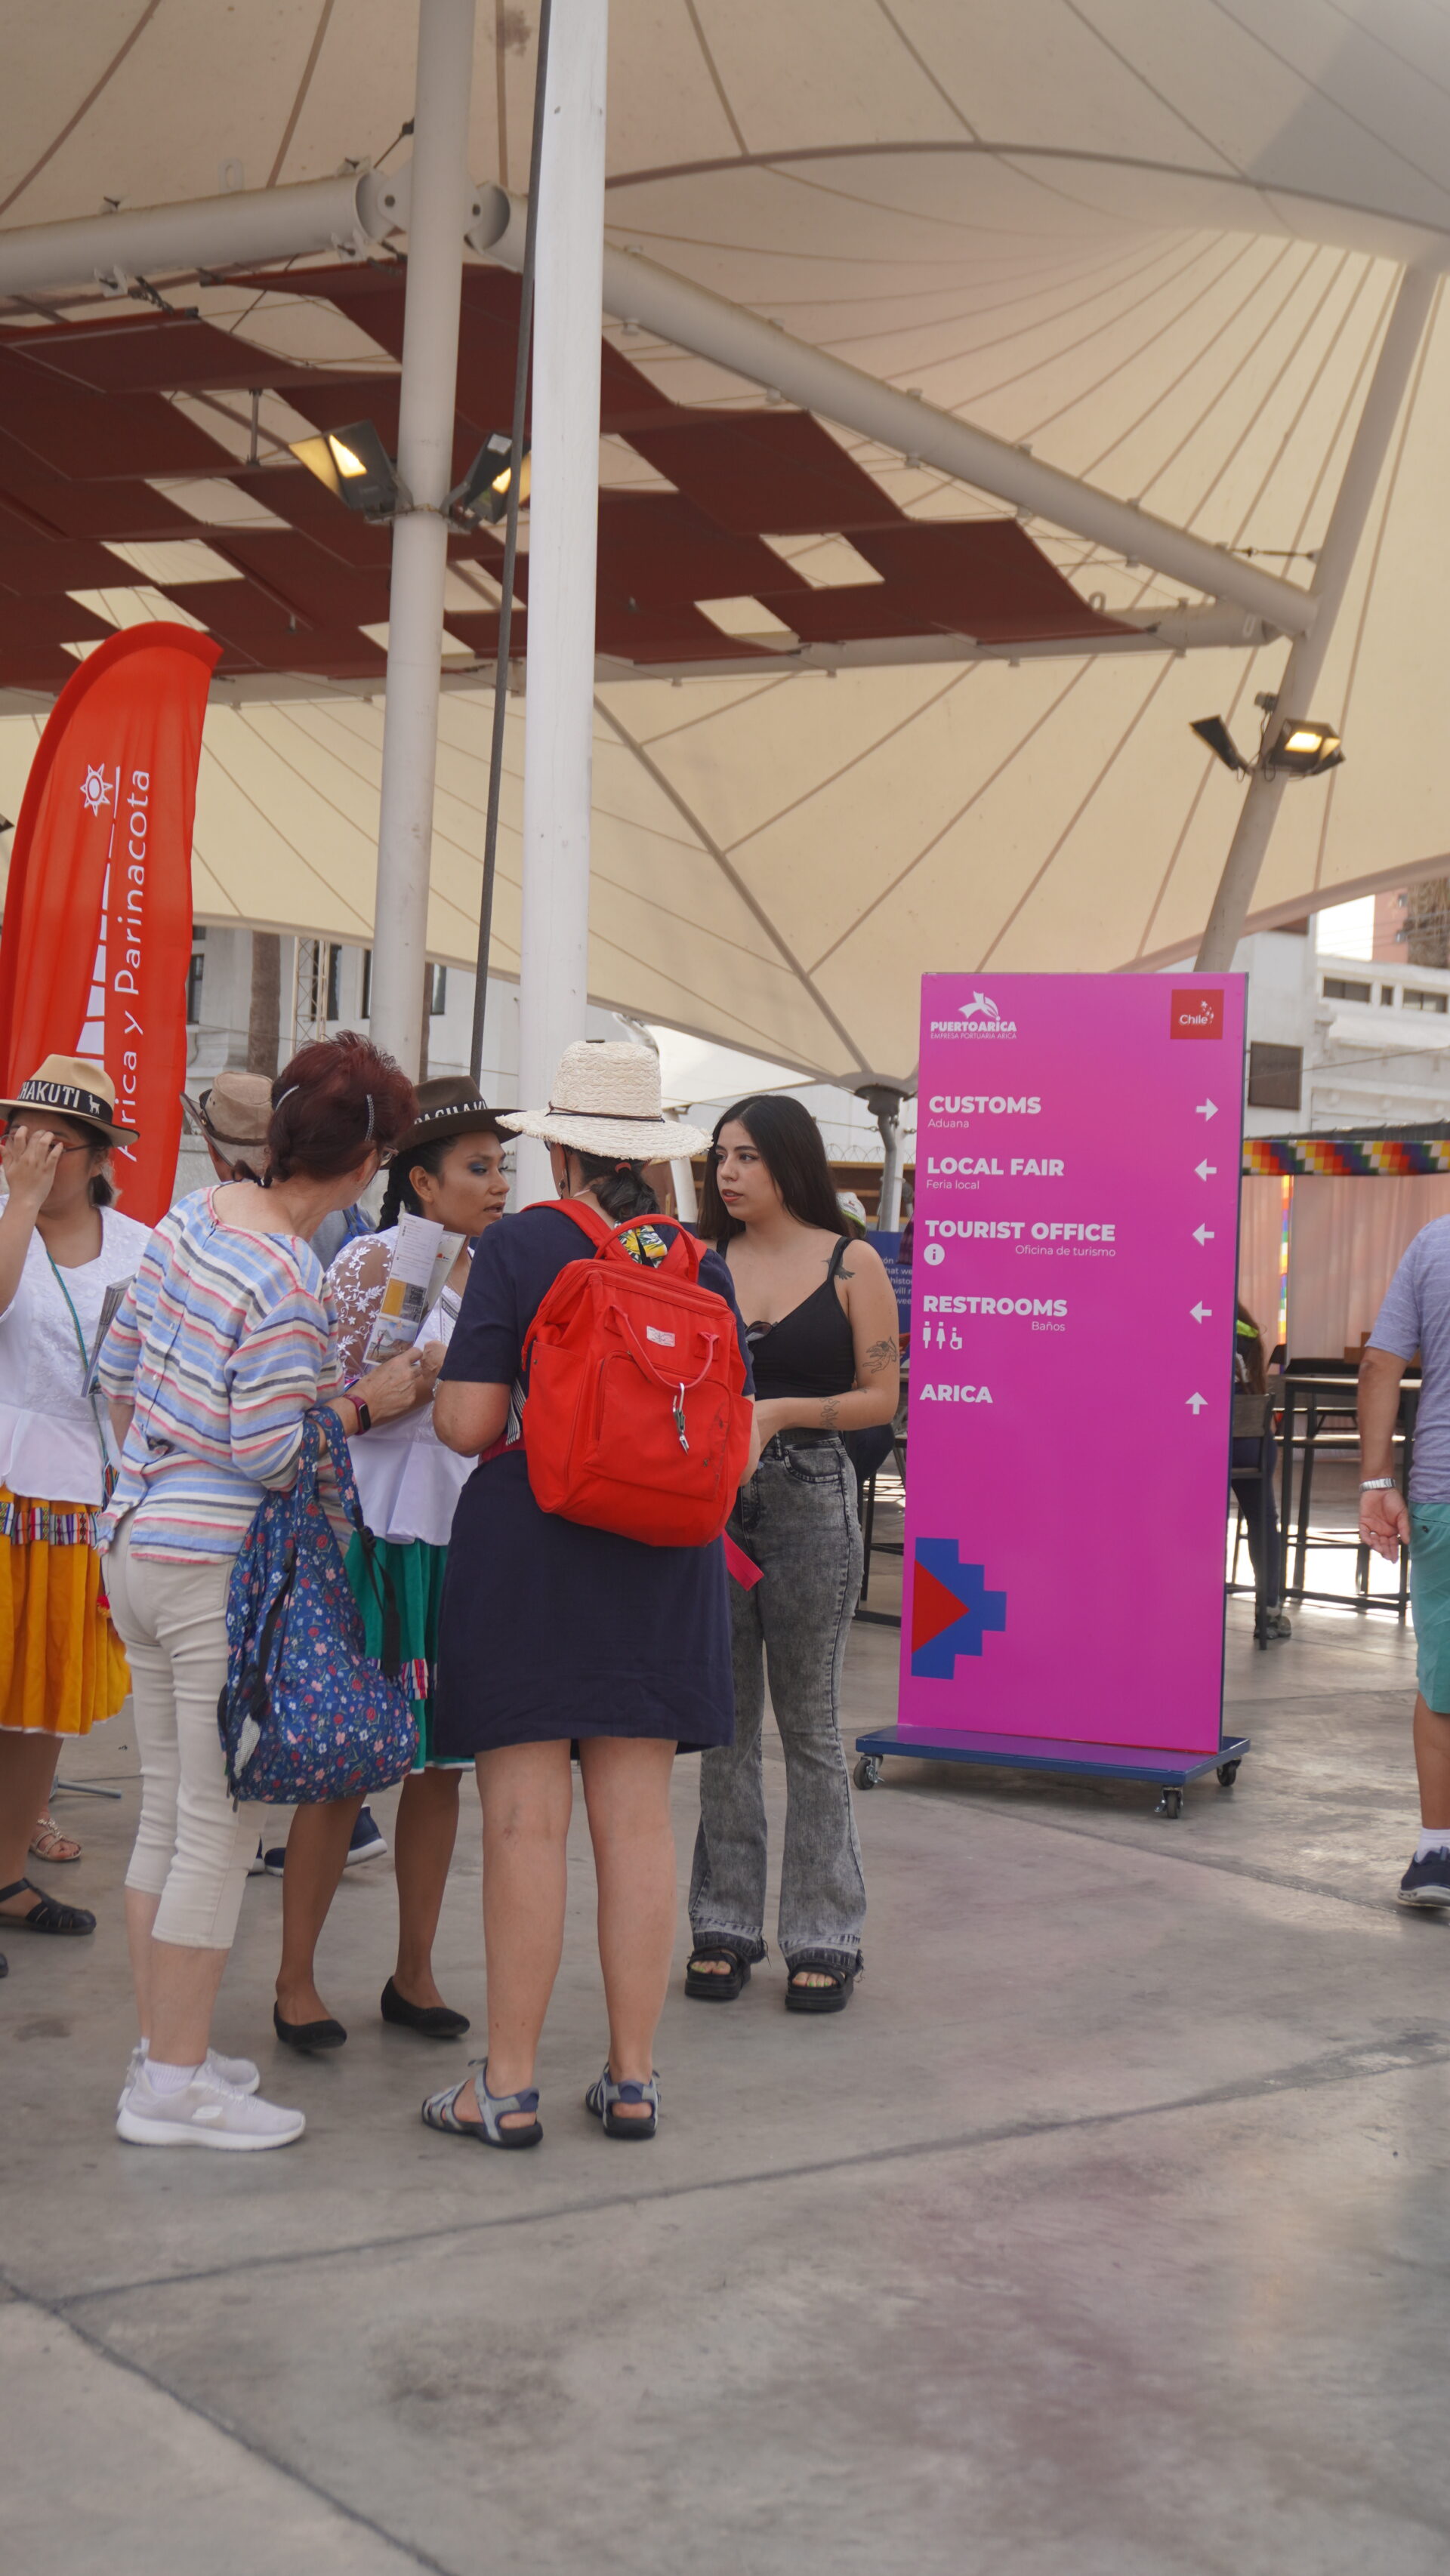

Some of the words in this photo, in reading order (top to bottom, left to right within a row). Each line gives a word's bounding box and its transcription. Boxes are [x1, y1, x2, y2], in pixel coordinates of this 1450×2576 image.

[114, 770, 150, 996] Parinacota
[124, 1010, 143, 1035] y
[930, 1021, 1017, 1032] PUERTOARICA
[1180, 1014, 1208, 1025] Chile
[17, 1081, 81, 1108] HAKUTI
[414, 1100, 487, 1125] ACHAK
[929, 1095, 1041, 1114] CUSTOMS
[927, 1118, 970, 1129] Aduana
[927, 1157, 1004, 1176] LOCAL
[1010, 1158, 1065, 1176] FAIR
[927, 1179, 952, 1189] Feria
[955, 1179, 980, 1190] local
[925, 1220, 1026, 1239] TOURIST
[1031, 1222, 1115, 1241] OFFICE
[1015, 1244, 1054, 1256] Oficina
[1056, 1246, 1071, 1256] de
[1072, 1247, 1116, 1257] turismo
[882, 1256, 894, 1265] ón
[924, 1295, 1068, 1317] RESTROOMS
[1032, 1320, 1066, 1332] Baños
[919, 1384, 993, 1404] ARICA
